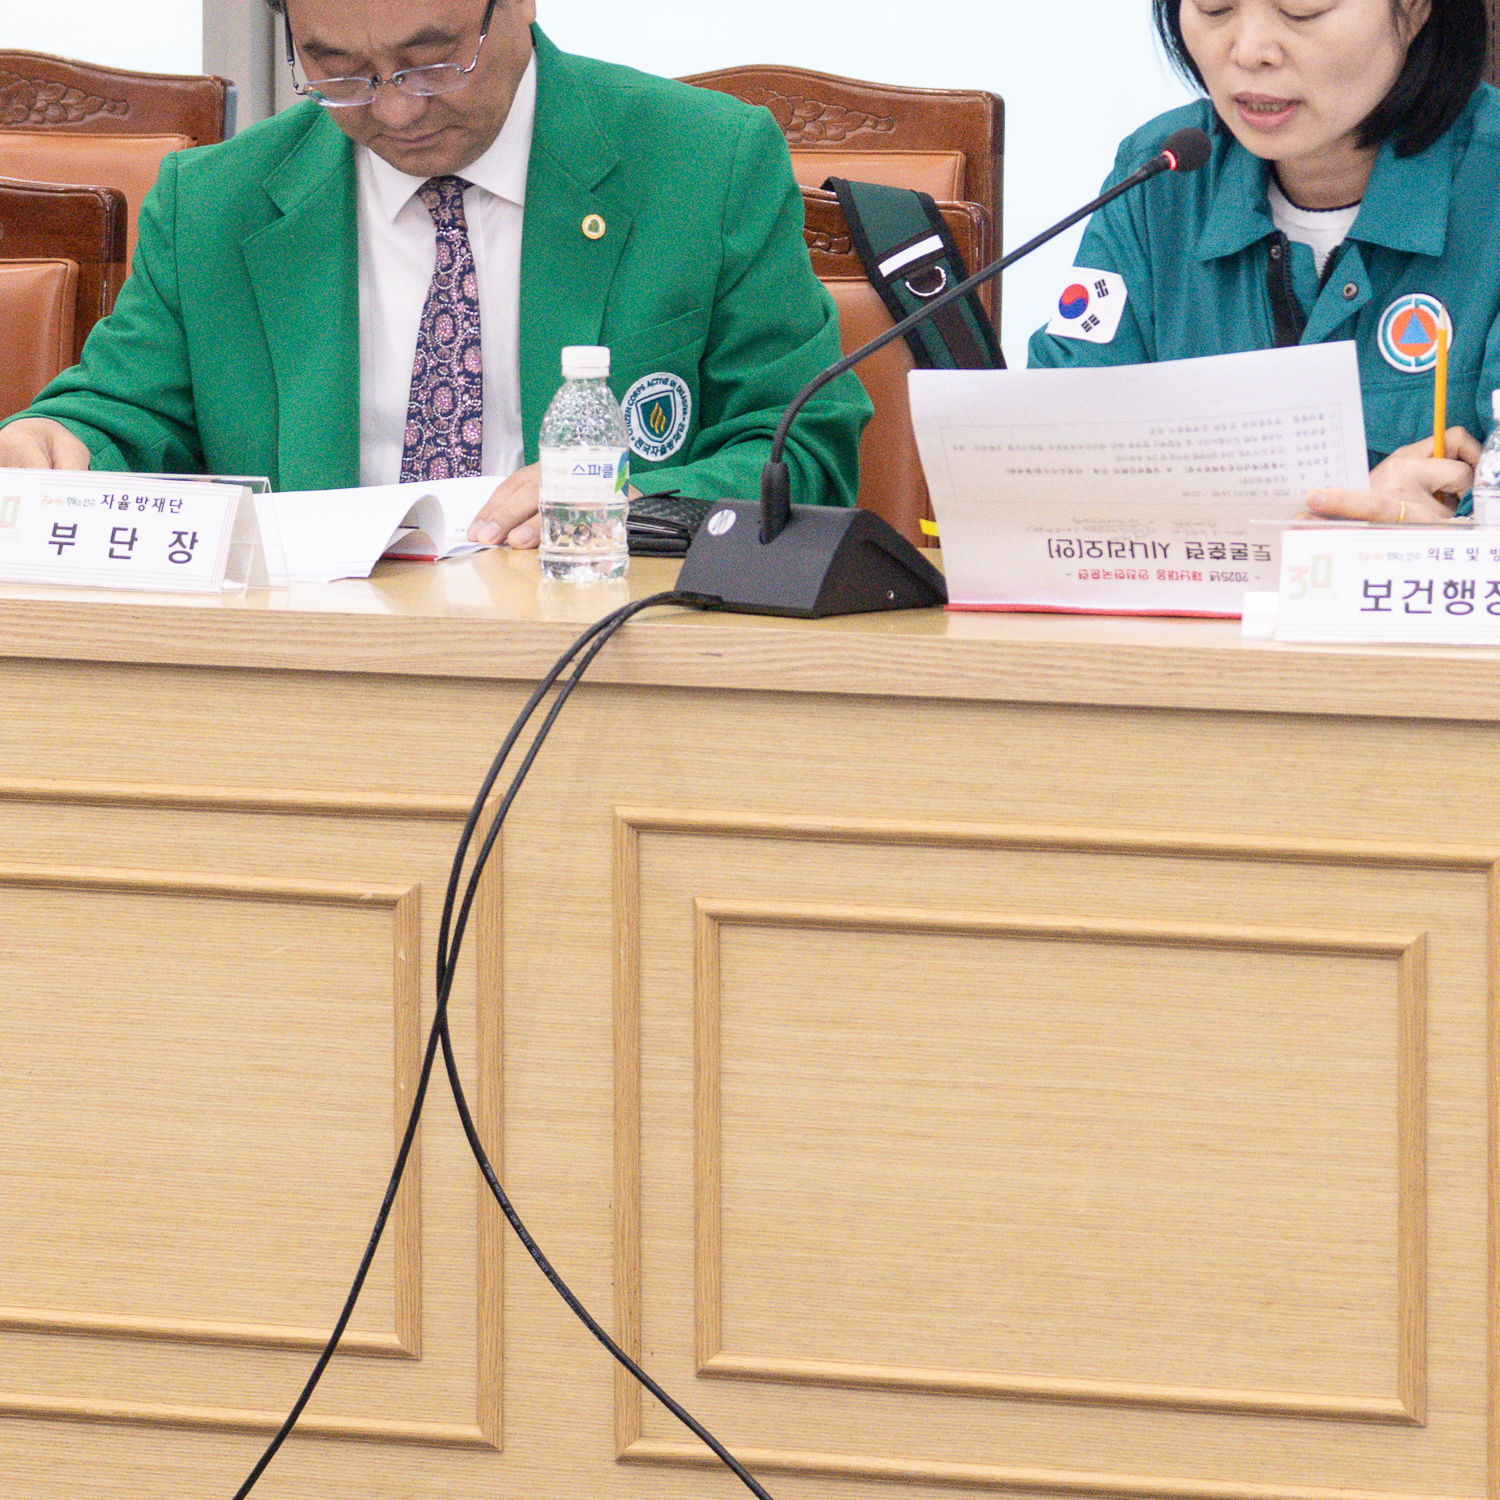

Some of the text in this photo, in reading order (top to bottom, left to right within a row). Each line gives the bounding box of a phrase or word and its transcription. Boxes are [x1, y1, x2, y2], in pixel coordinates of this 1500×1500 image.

[628, 384, 646, 406] CORPS
[647, 378, 669, 388] ACTIVE
[571, 463, 614, 478] 스파클
[100, 494, 183, 514] 자율방재단
[1185, 541, 1271, 561] 토론훈련
[1427, 547, 1455, 561] 의료
[1466, 547, 1479, 561] 및
[1078, 568, 1149, 580] 안전한국훈련
[1156, 569, 1203, 581] 재난대응
[1209, 570, 1249, 582] 2025년
